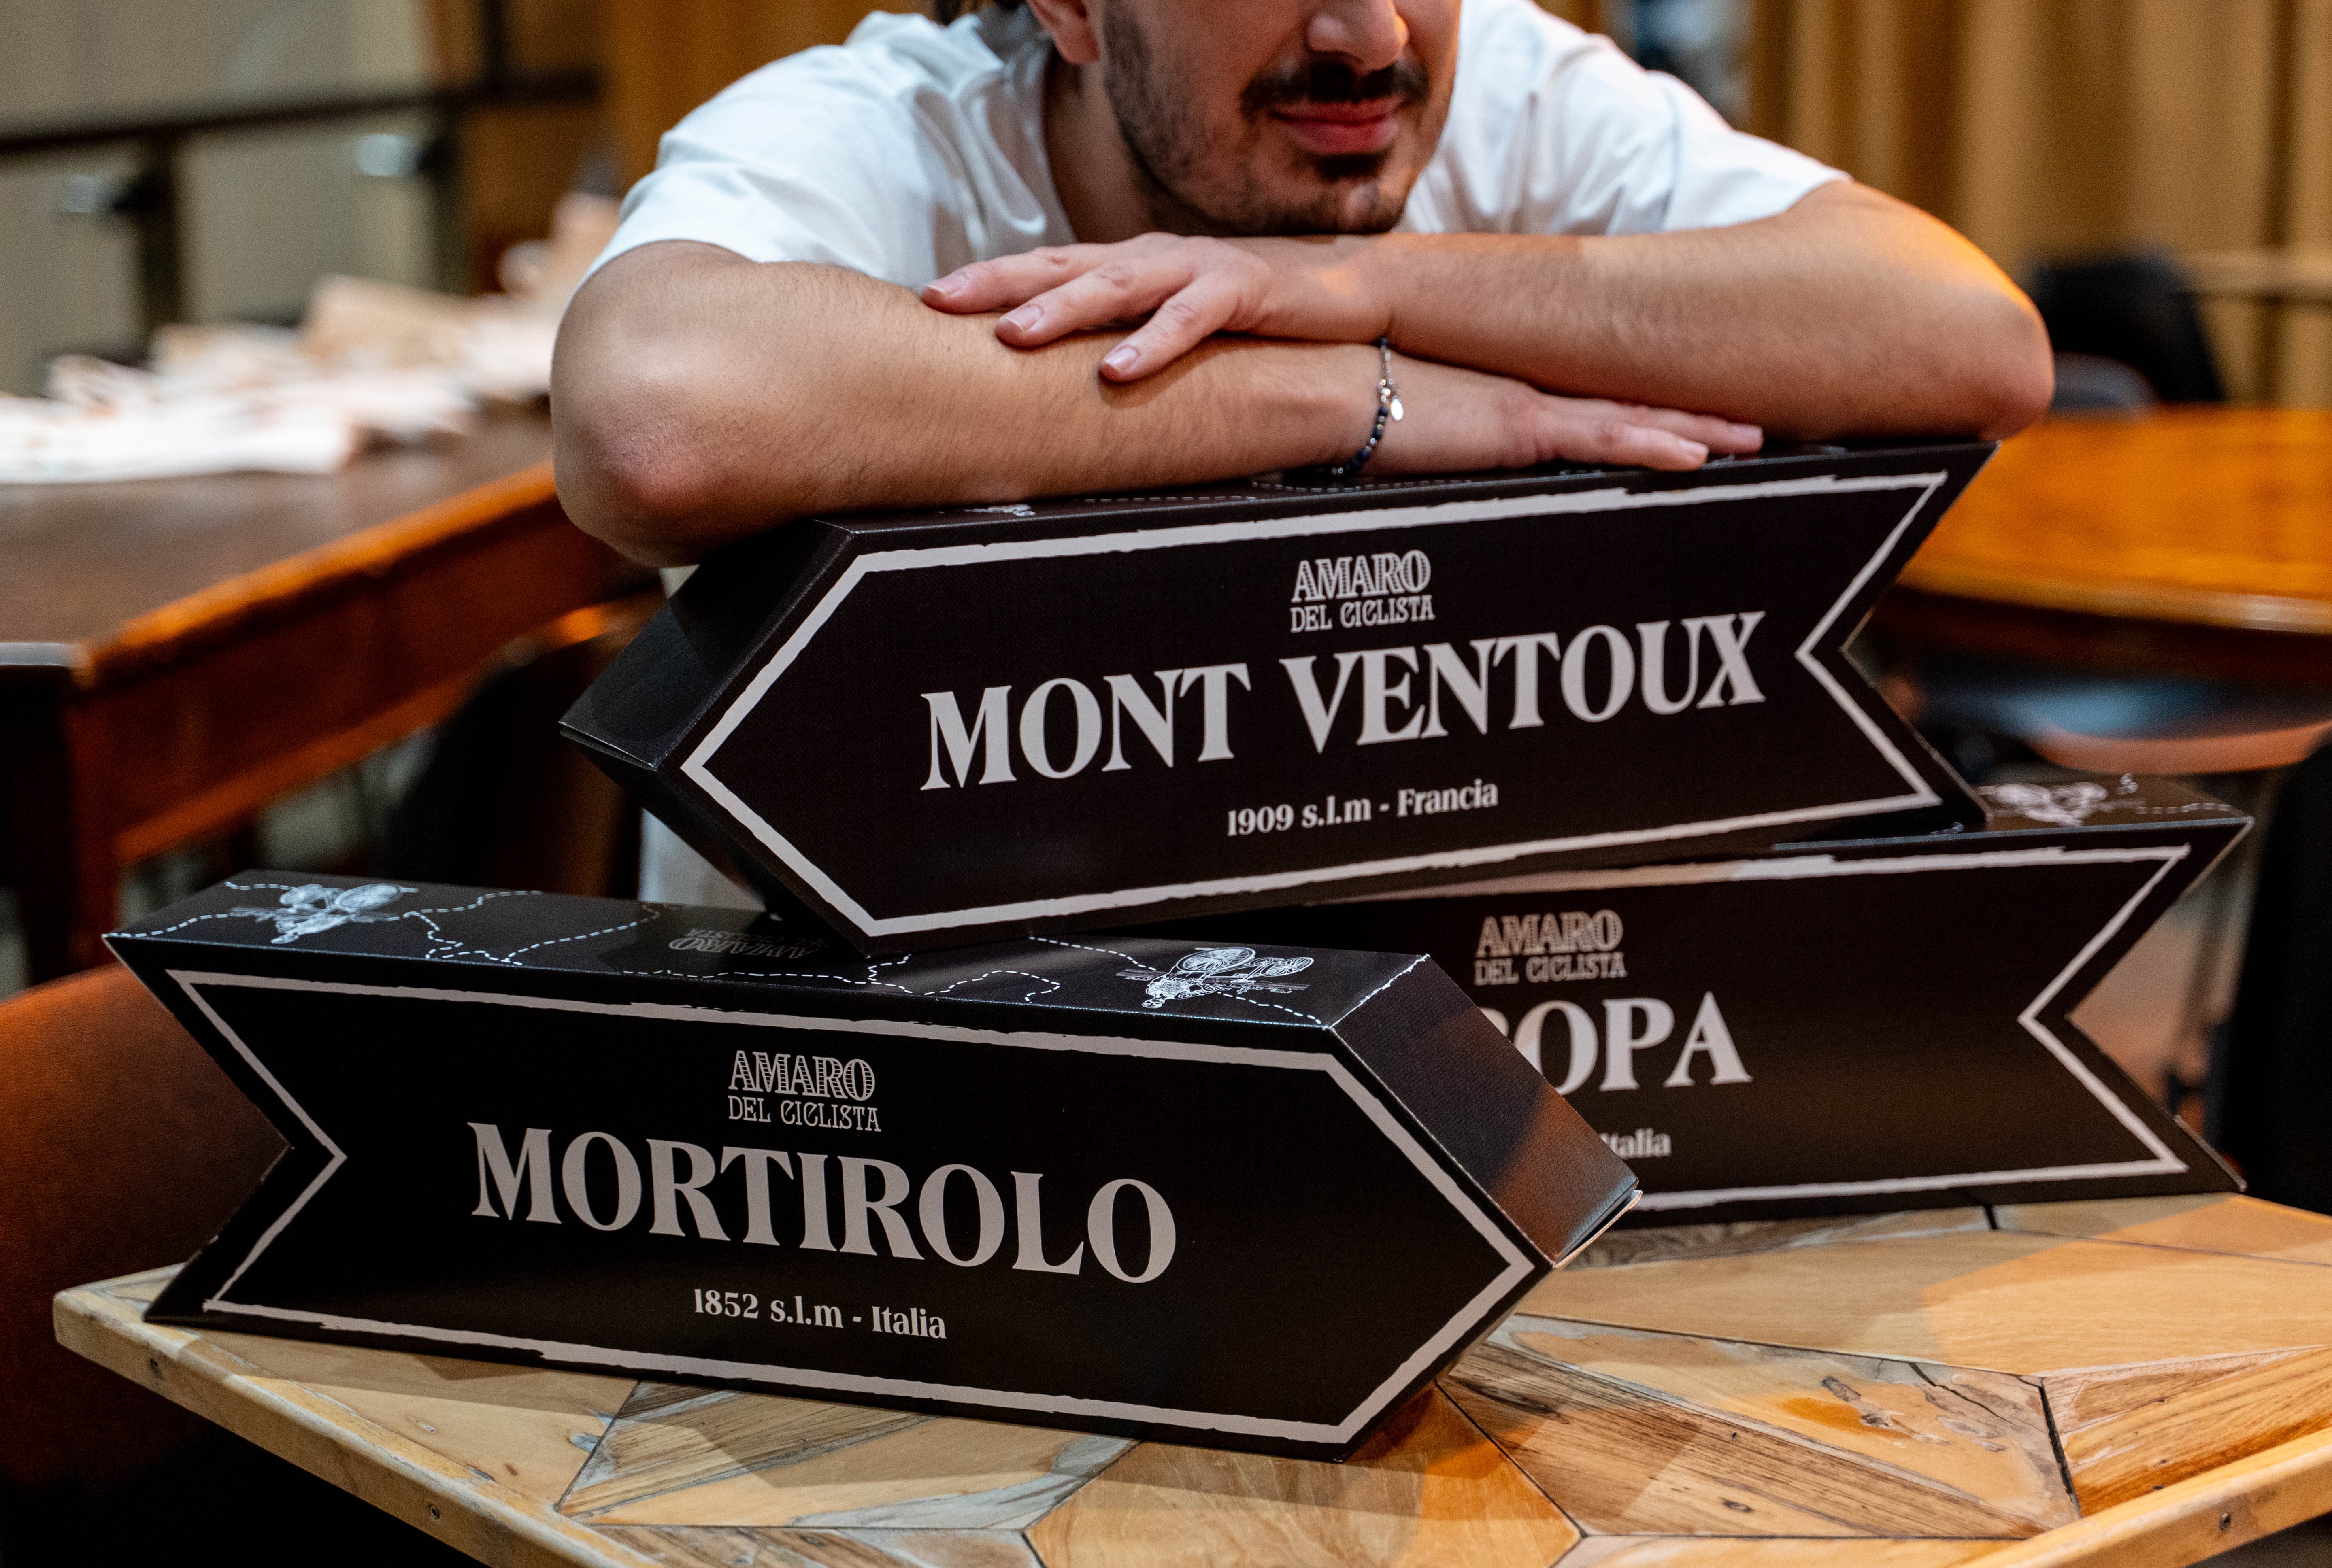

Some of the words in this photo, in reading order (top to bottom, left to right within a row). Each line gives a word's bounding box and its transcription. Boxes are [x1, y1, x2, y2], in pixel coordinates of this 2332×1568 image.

[1291, 550, 1432, 603] AMARO
[1290, 604, 1333, 633] DEL
[1340, 594, 1436, 629] CICLISTA
[920, 663, 1251, 790] MONT
[1279, 611, 1765, 753] VENTOUX
[1228, 804, 1294, 836] 1909
[1301, 795, 1372, 828] s.l.m
[1397, 778, 1498, 817] Francia
[1474, 909, 1624, 958] AMARO
[1474, 958, 1519, 986] DEL
[1526, 952, 1628, 983] CICLISTA
[1478, 991, 1753, 1096] OPA
[728, 1050, 875, 1101] AMARO
[728, 1095, 771, 1123] DEL
[781, 1100, 881, 1132] CICLISTA
[1599, 1127, 1672, 1160] talia
[467, 1122, 1176, 1284] MORTIROLO
[694, 1288, 759, 1319] 1852
[770, 1295, 843, 1328] s.l.m
[872, 1306, 947, 1339] Italia
